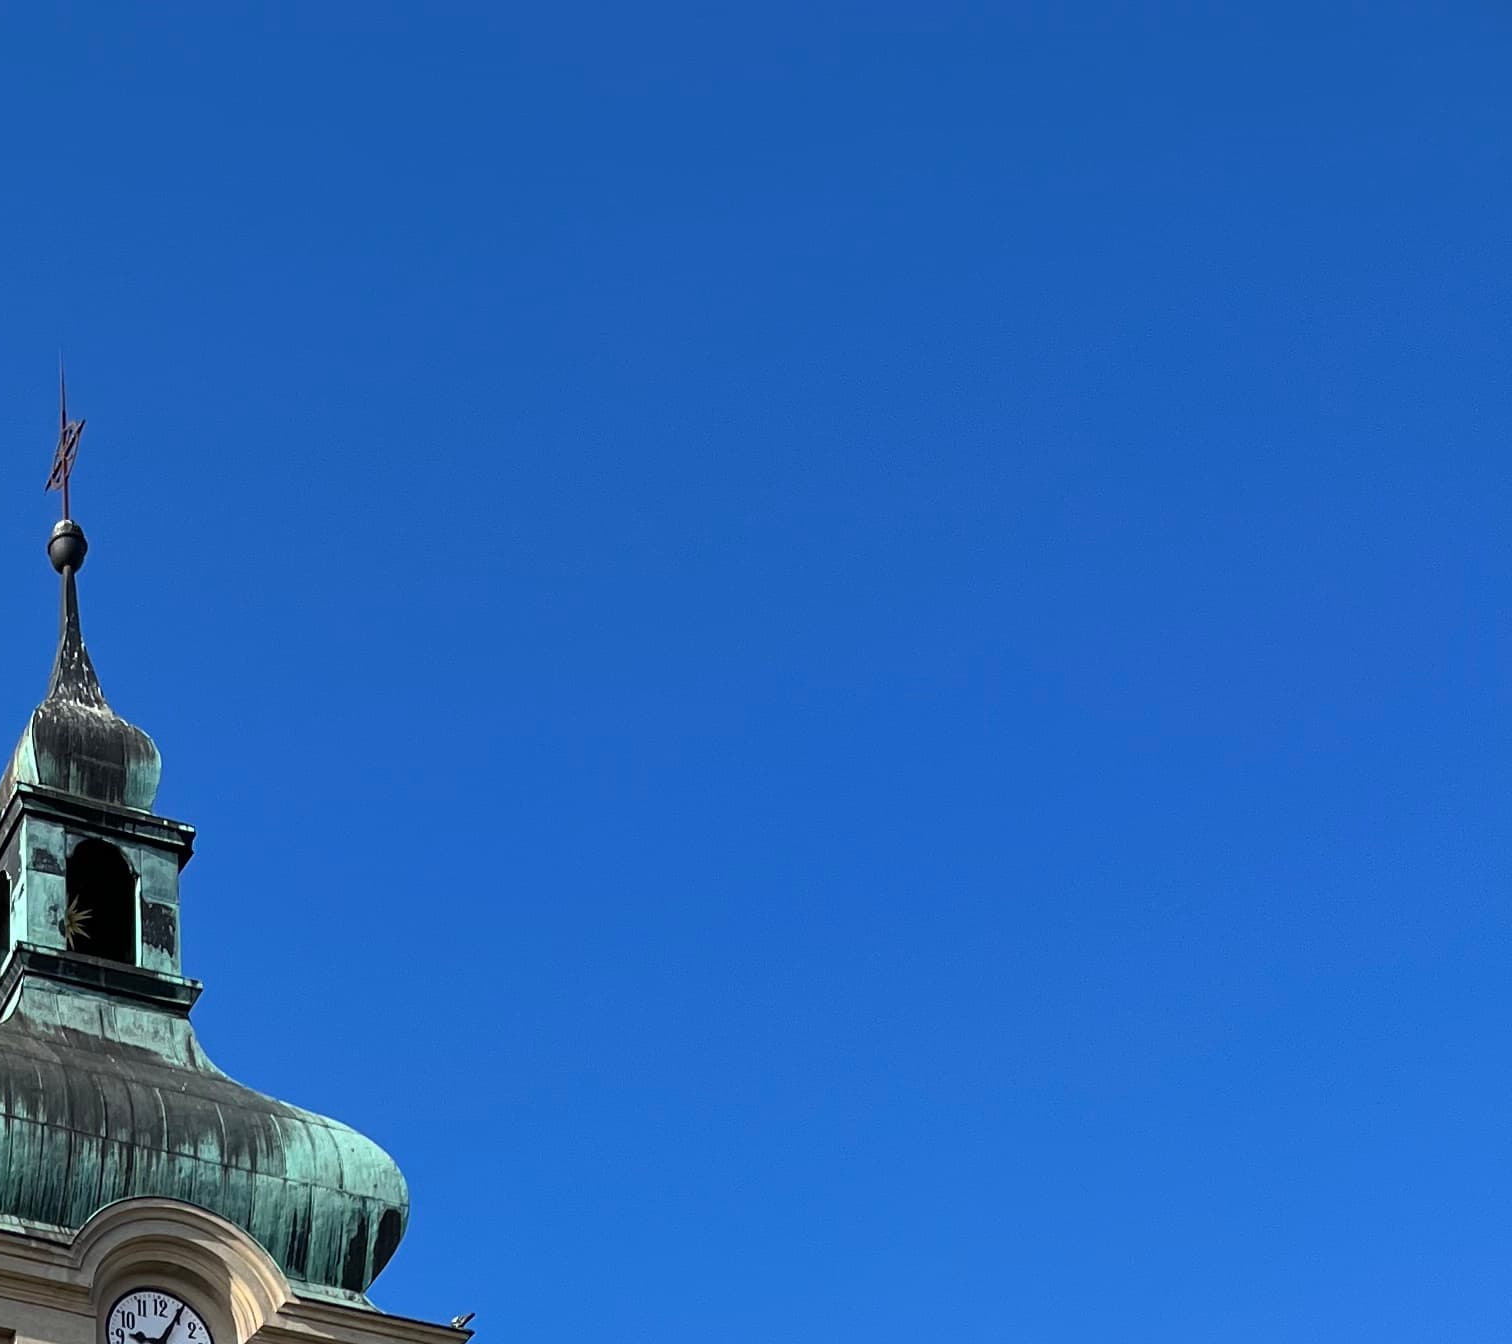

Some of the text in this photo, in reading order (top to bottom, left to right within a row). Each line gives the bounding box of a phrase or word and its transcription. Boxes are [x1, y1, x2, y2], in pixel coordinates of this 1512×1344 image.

[137, 1299, 146, 1317] 11
[154, 1299, 168, 1317] 12
[121, 1311, 135, 1329] 10
[188, 1322, 197, 1339] 2
